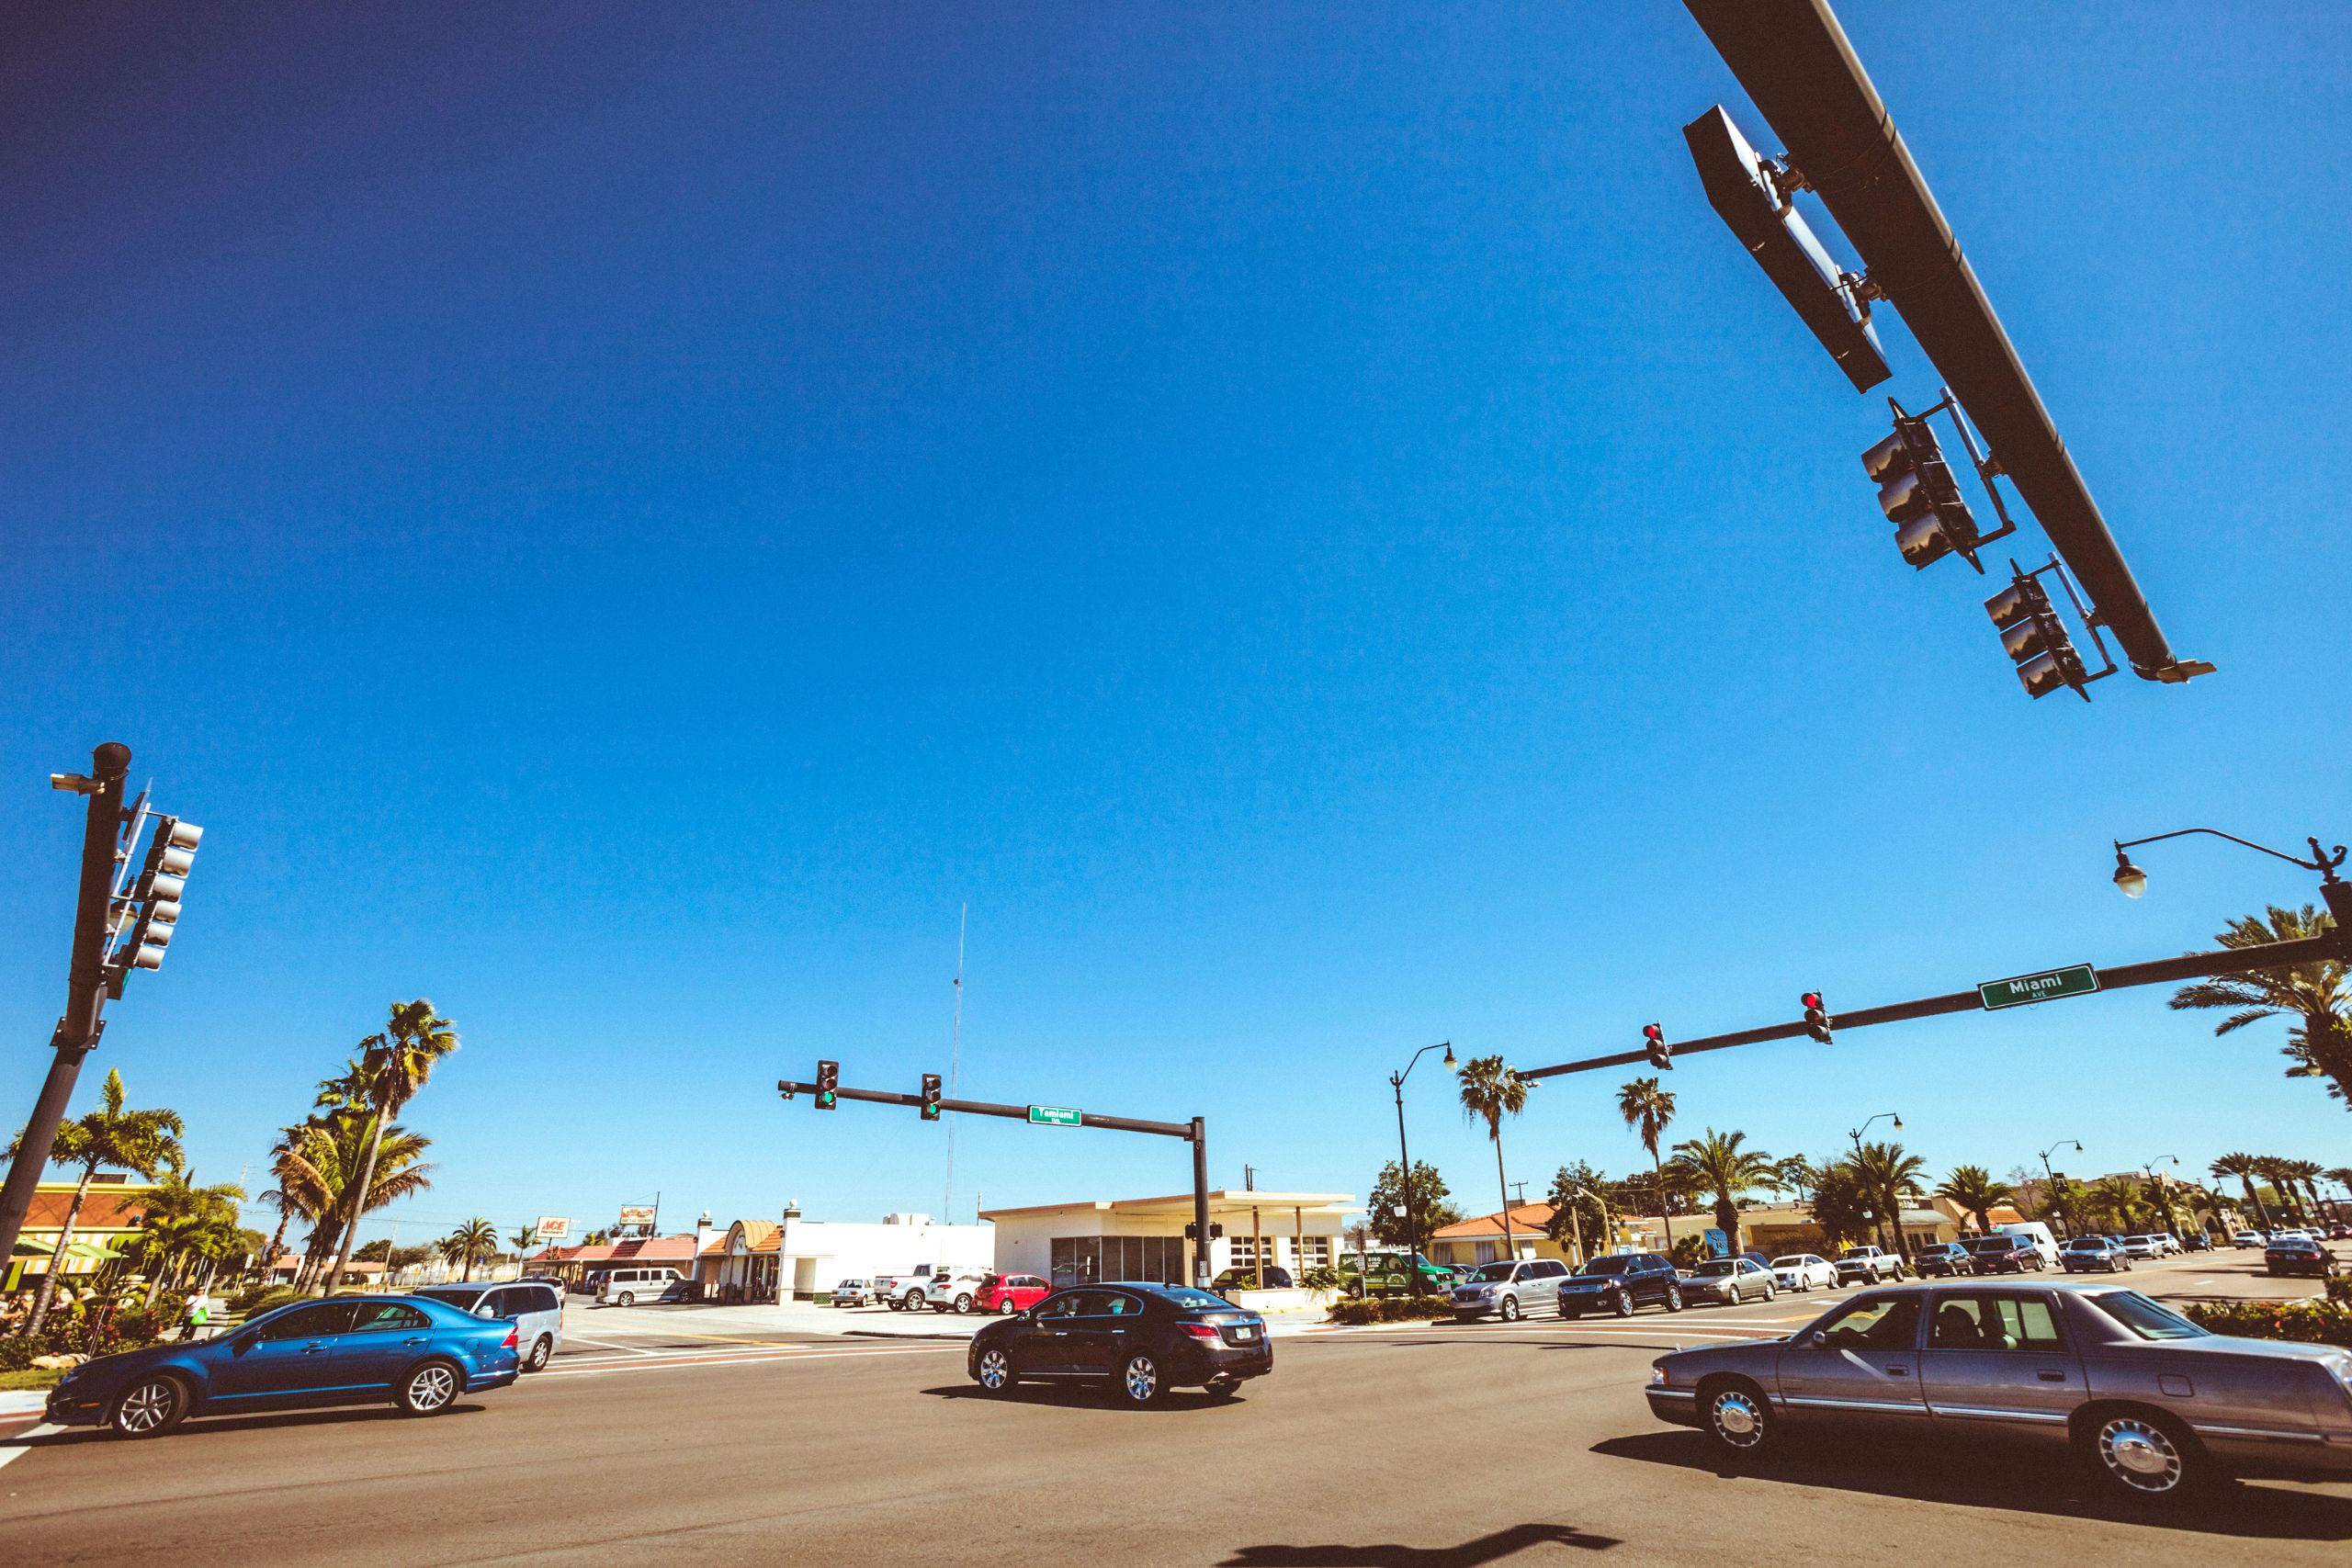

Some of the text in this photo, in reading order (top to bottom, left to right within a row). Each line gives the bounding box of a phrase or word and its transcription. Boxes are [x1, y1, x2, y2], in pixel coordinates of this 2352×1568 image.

[2008, 974, 2063, 994] Miami
[2032, 990, 2047, 998] AVE
[1038, 1108, 1074, 1119] Tamiami
[541, 1220, 566, 1230] ACE
